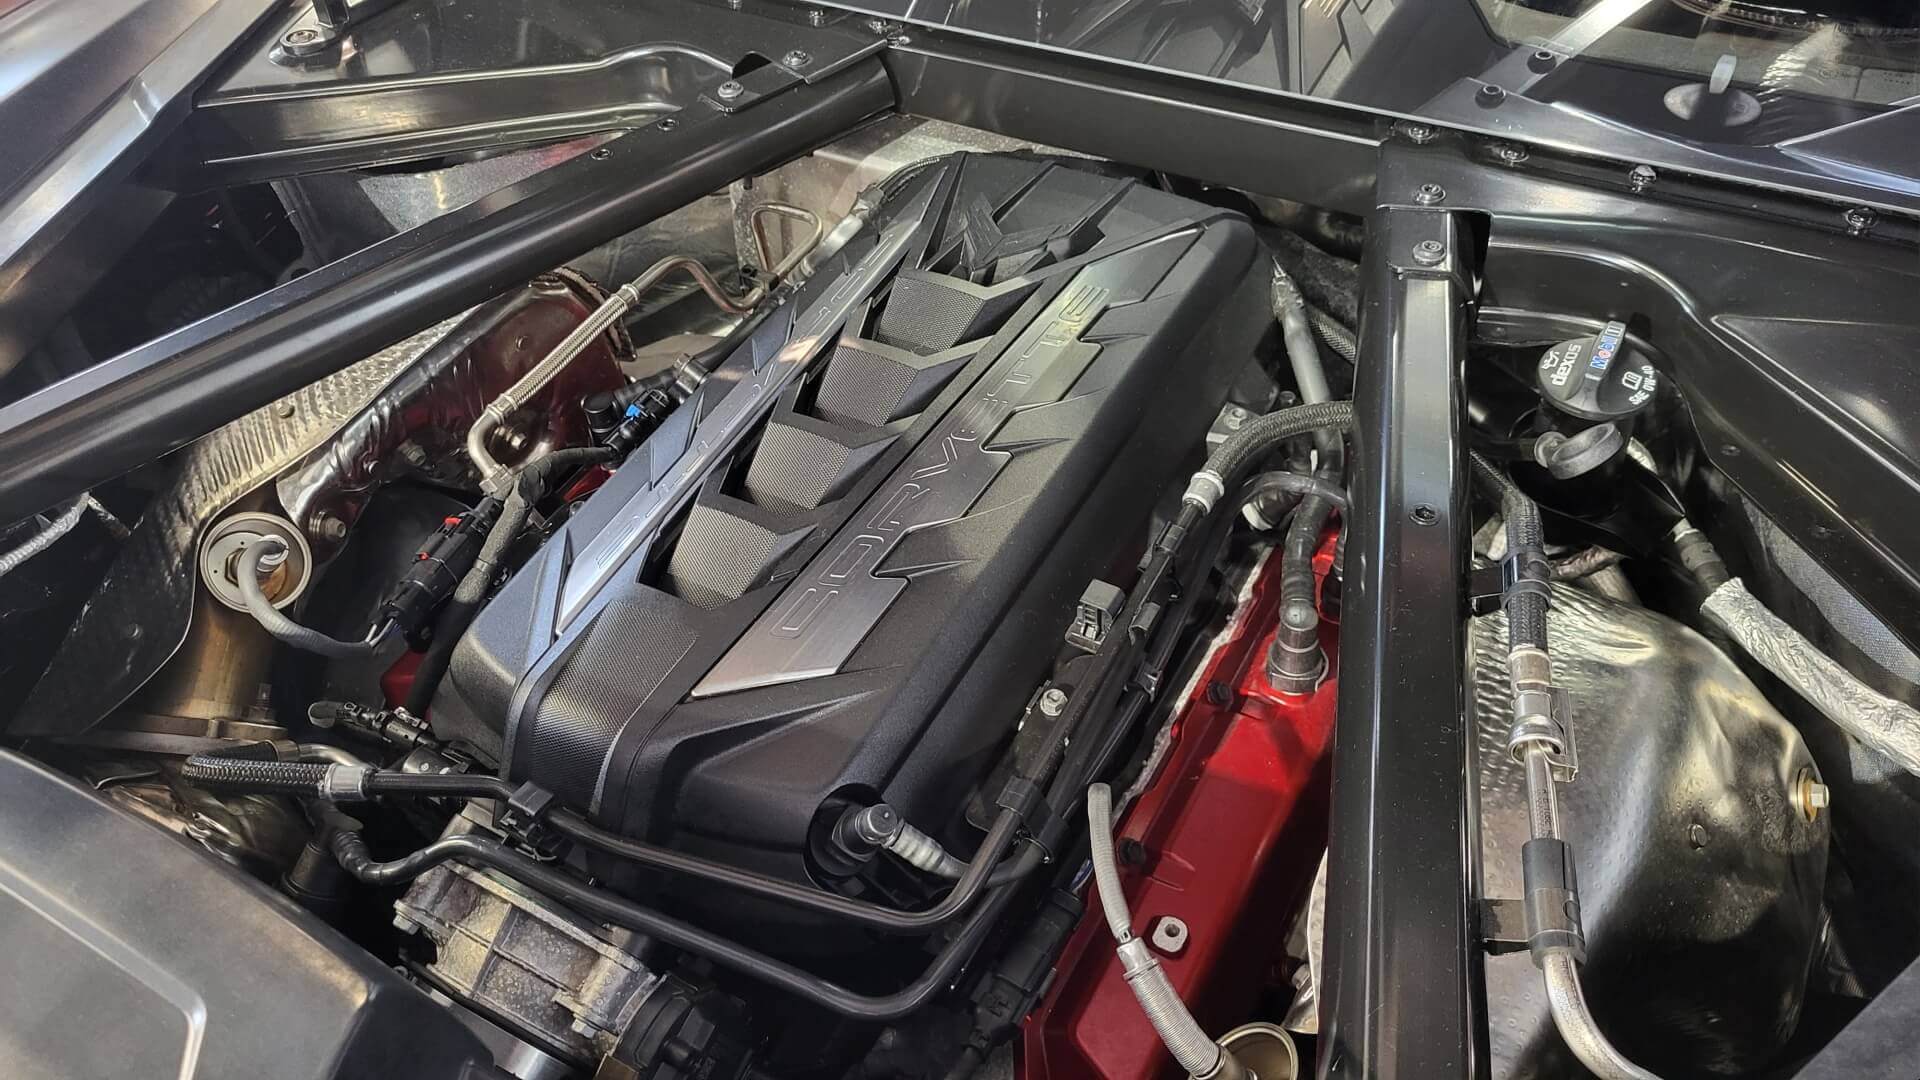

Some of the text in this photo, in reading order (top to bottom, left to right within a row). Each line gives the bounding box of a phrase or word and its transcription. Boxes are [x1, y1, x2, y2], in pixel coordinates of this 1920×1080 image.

[1550, 344, 1581, 386] dexos
[1590, 335, 1616, 370] Mobil
[1629, 365, 1657, 405] SAE 0W-40
